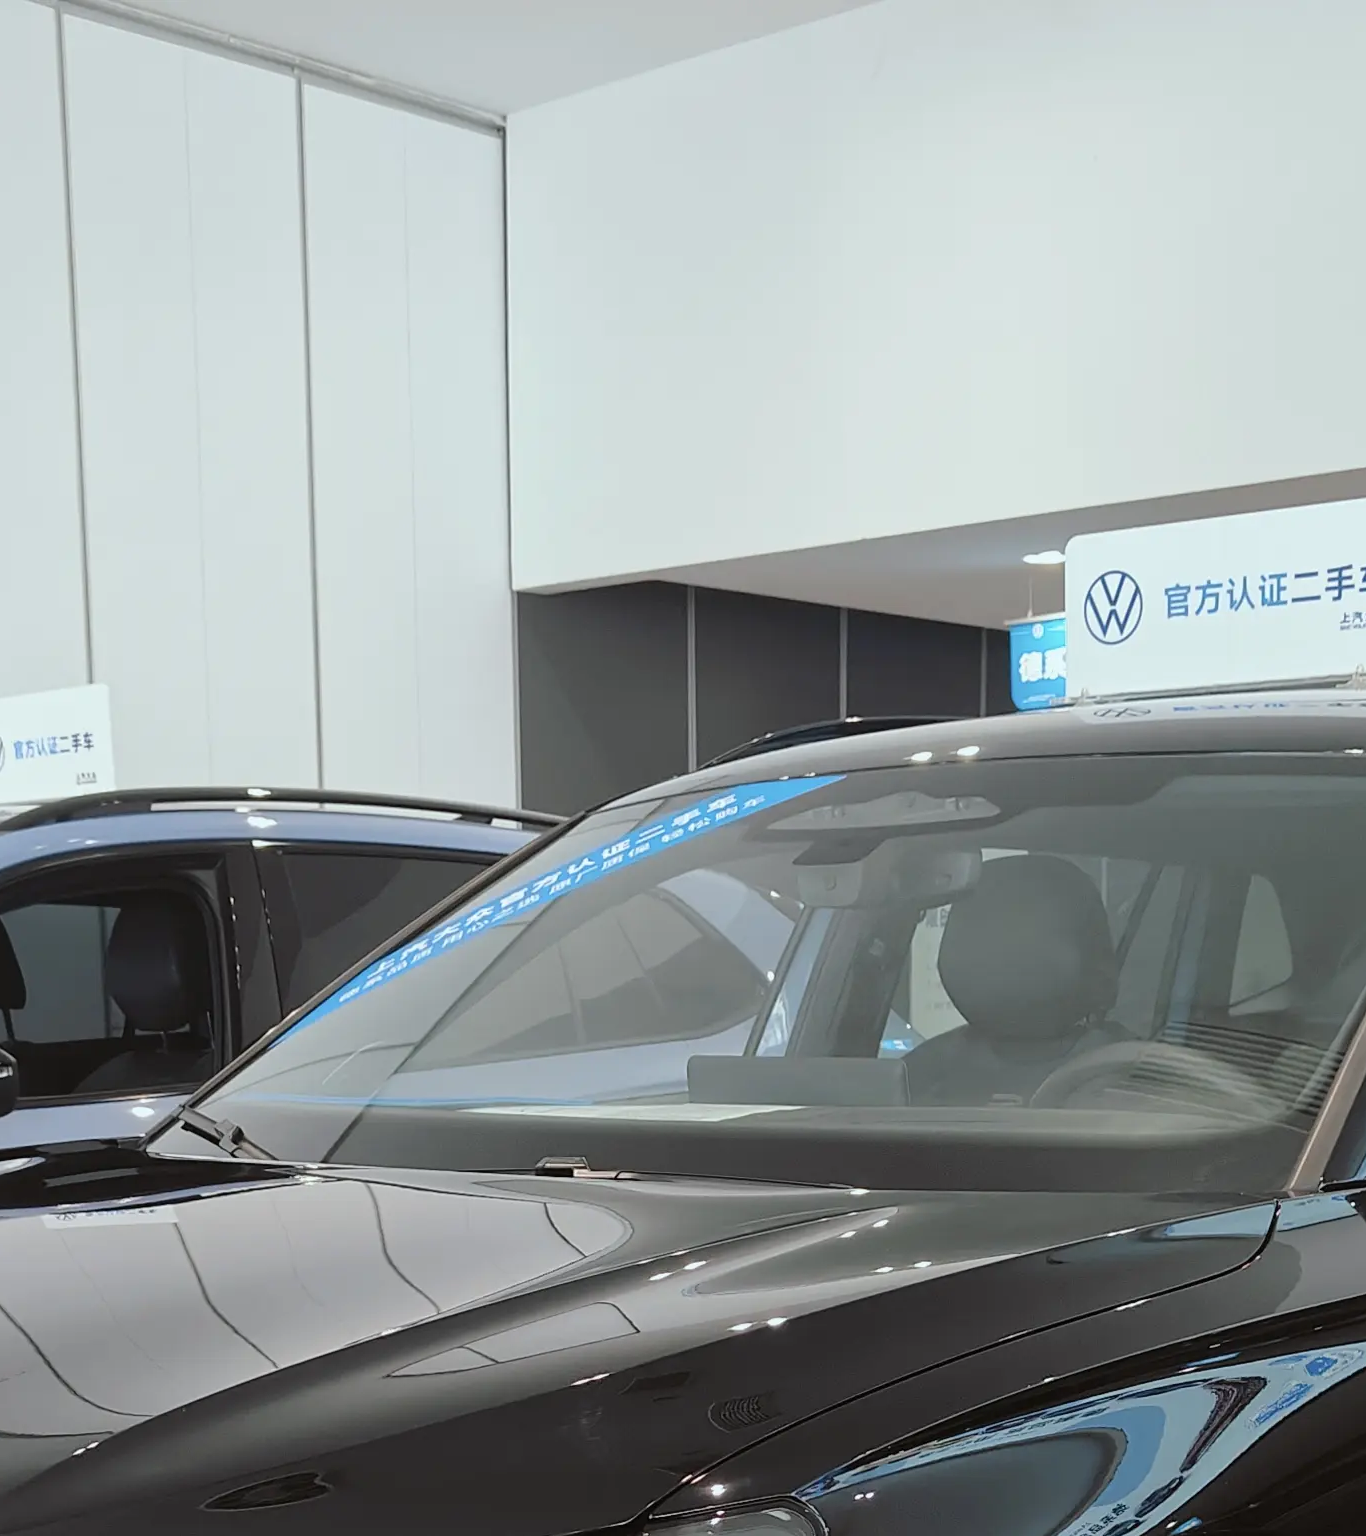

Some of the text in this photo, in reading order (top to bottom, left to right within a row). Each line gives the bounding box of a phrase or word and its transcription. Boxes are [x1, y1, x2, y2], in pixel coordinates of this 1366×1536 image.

[13, 732, 95, 760] 官方认证二手车
